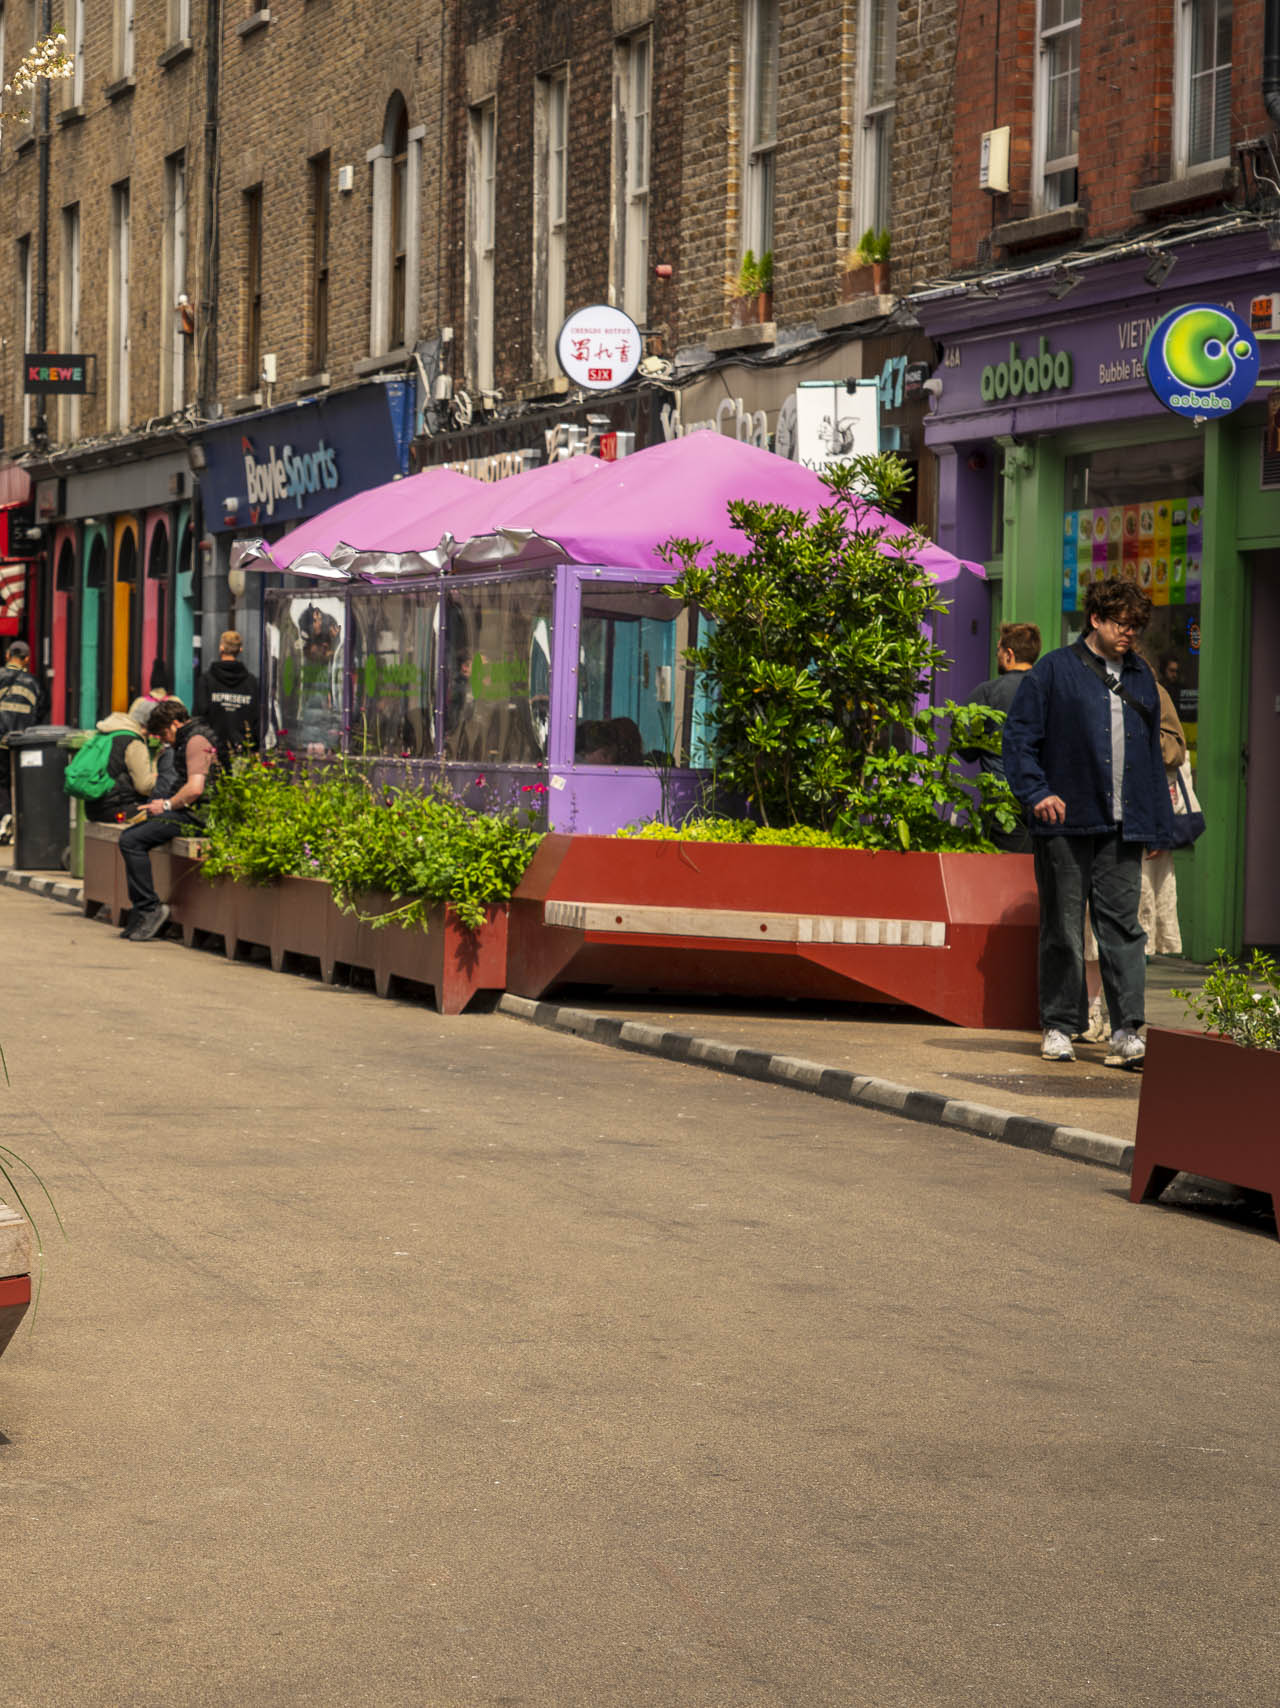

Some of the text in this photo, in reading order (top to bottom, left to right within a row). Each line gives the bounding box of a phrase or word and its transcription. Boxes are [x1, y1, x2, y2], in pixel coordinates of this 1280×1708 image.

[29, 367, 83, 381] KREWE
[590, 369, 609, 380] SJX
[981, 336, 1070, 401] aobaba
[1099, 359, 1130, 384] Bubble
[880, 355, 908, 410] 47
[1170, 391, 1231, 409] aobaba
[245, 439, 338, 516] BoyleSports
